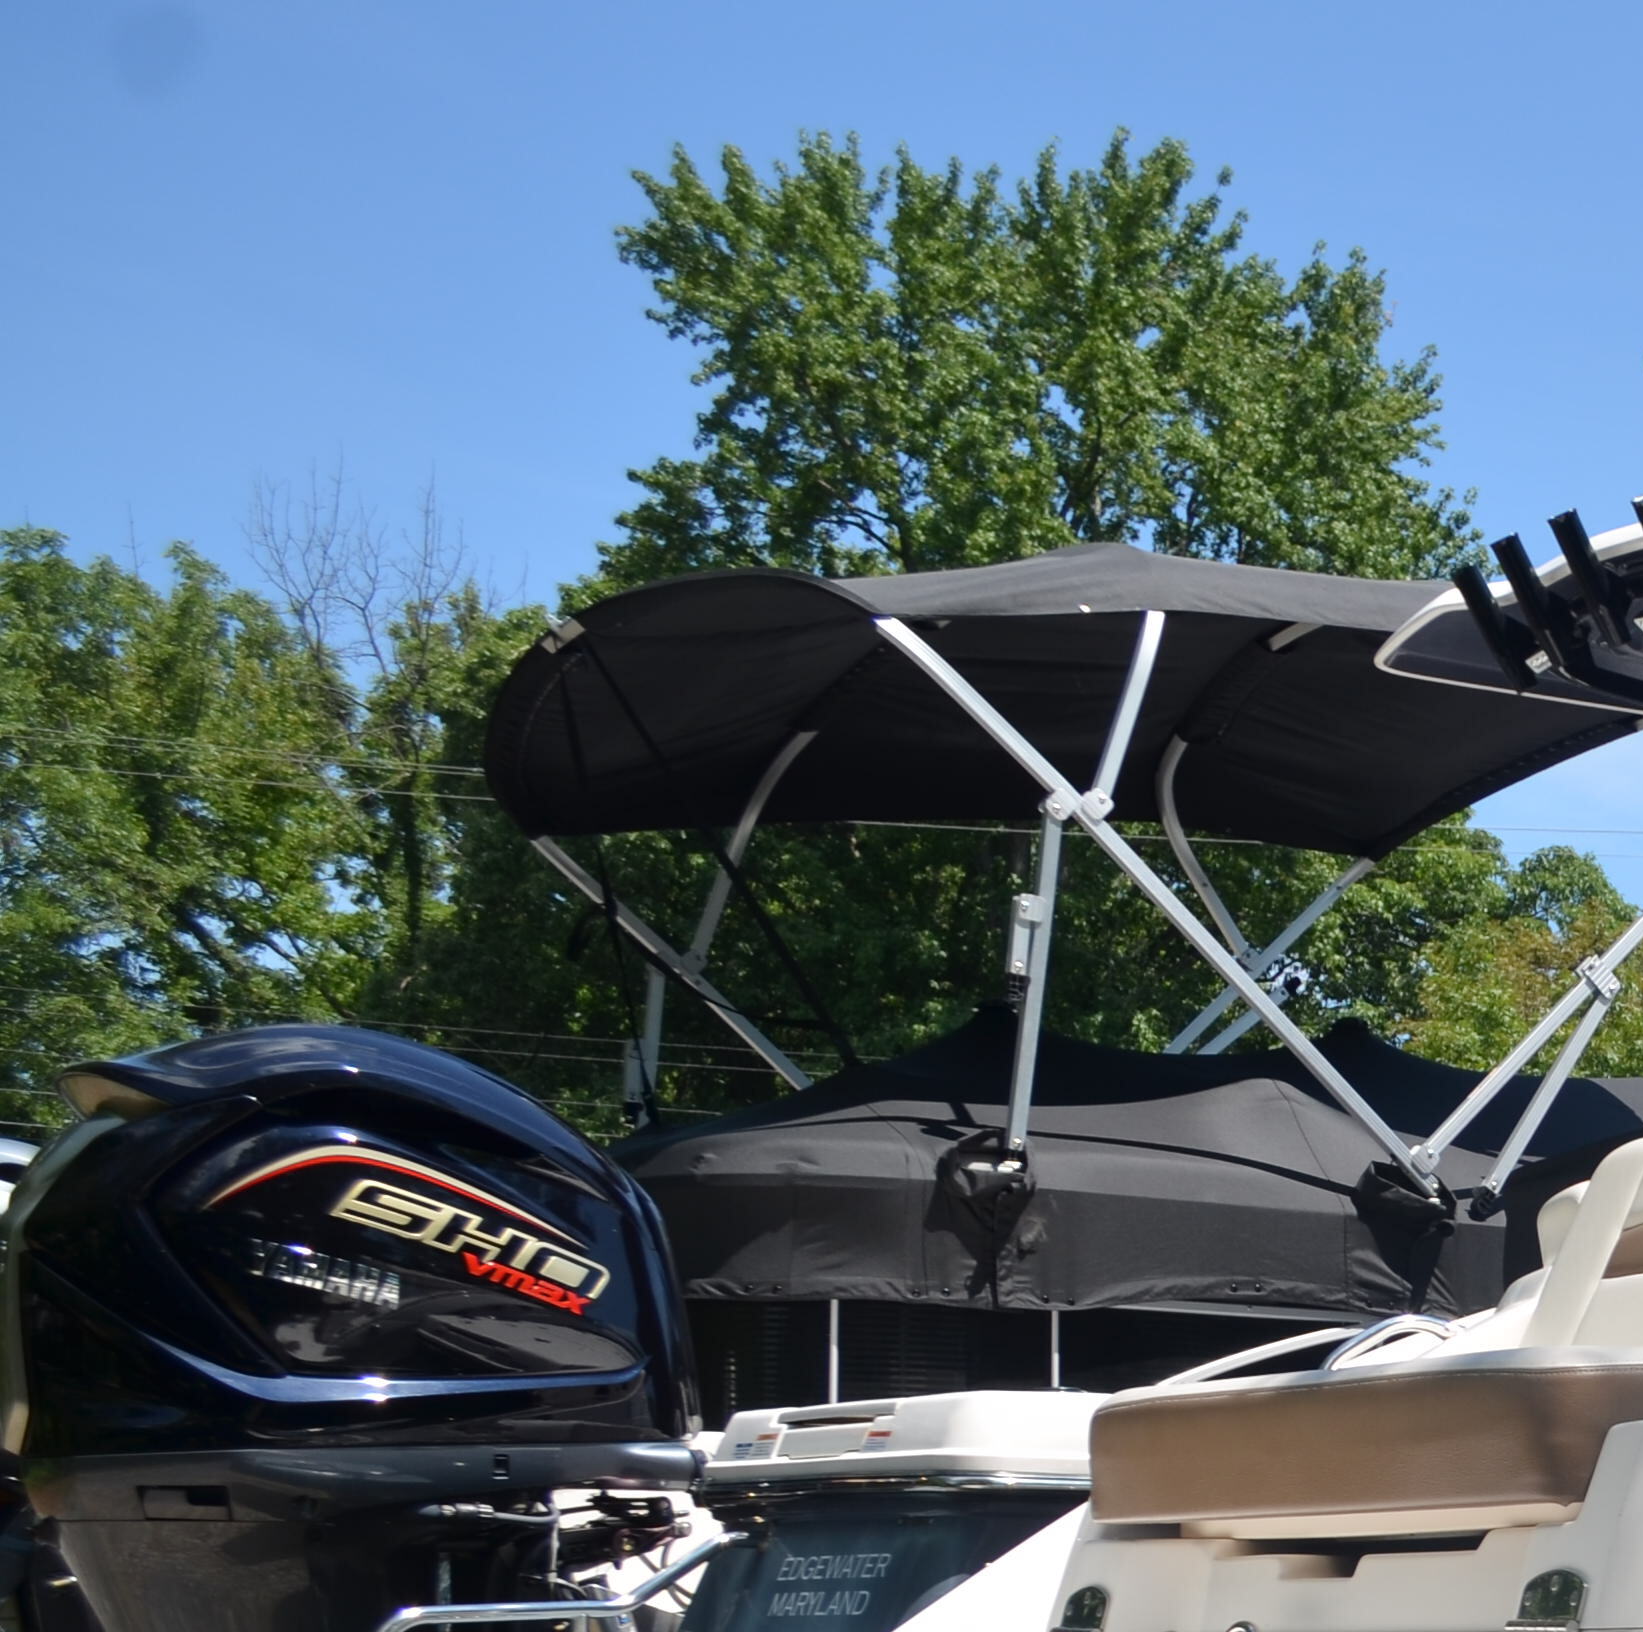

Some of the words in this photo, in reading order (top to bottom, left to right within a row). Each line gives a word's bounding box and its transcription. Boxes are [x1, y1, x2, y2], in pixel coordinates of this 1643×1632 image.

[329, 1179, 611, 1300] SHO
[249, 1238, 400, 1310] YAMAHA
[776, 1553, 892, 1581] EDGEWATER
[766, 1591, 870, 1616] MARYLAND
